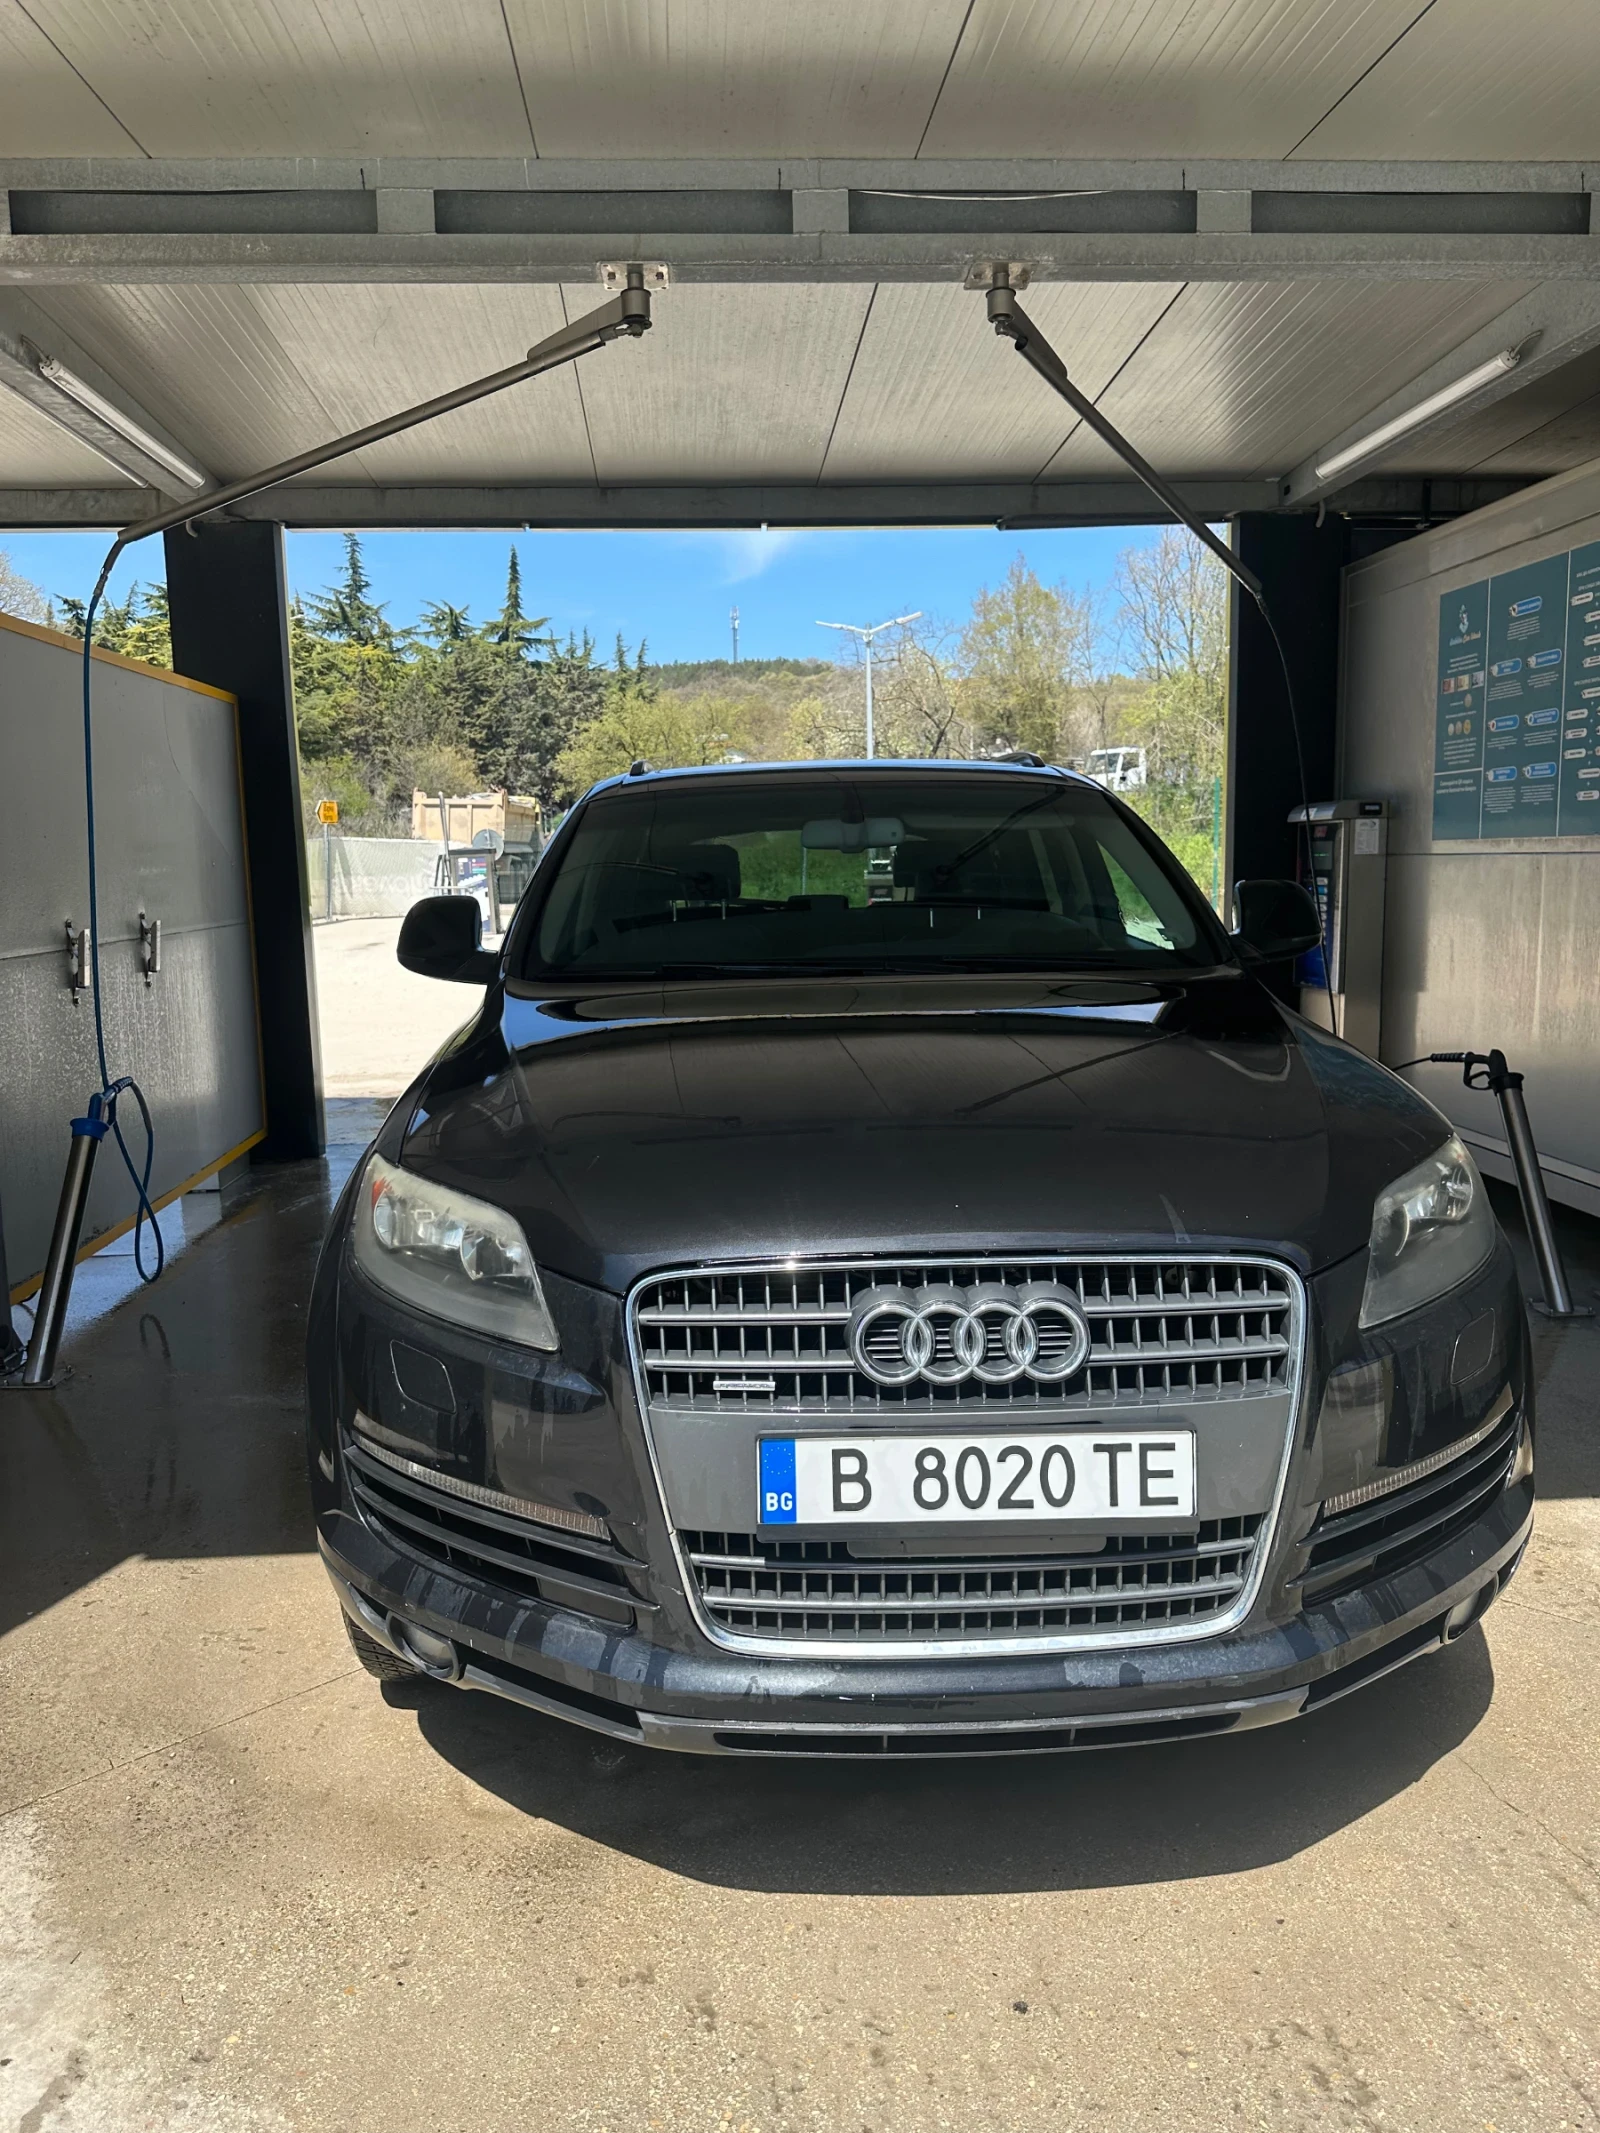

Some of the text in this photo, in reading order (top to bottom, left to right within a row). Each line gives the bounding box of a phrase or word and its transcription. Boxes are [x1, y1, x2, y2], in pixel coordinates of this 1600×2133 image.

[831, 1442, 1179, 1512] B 8020 TE
[765, 1492, 793, 1512] BG
